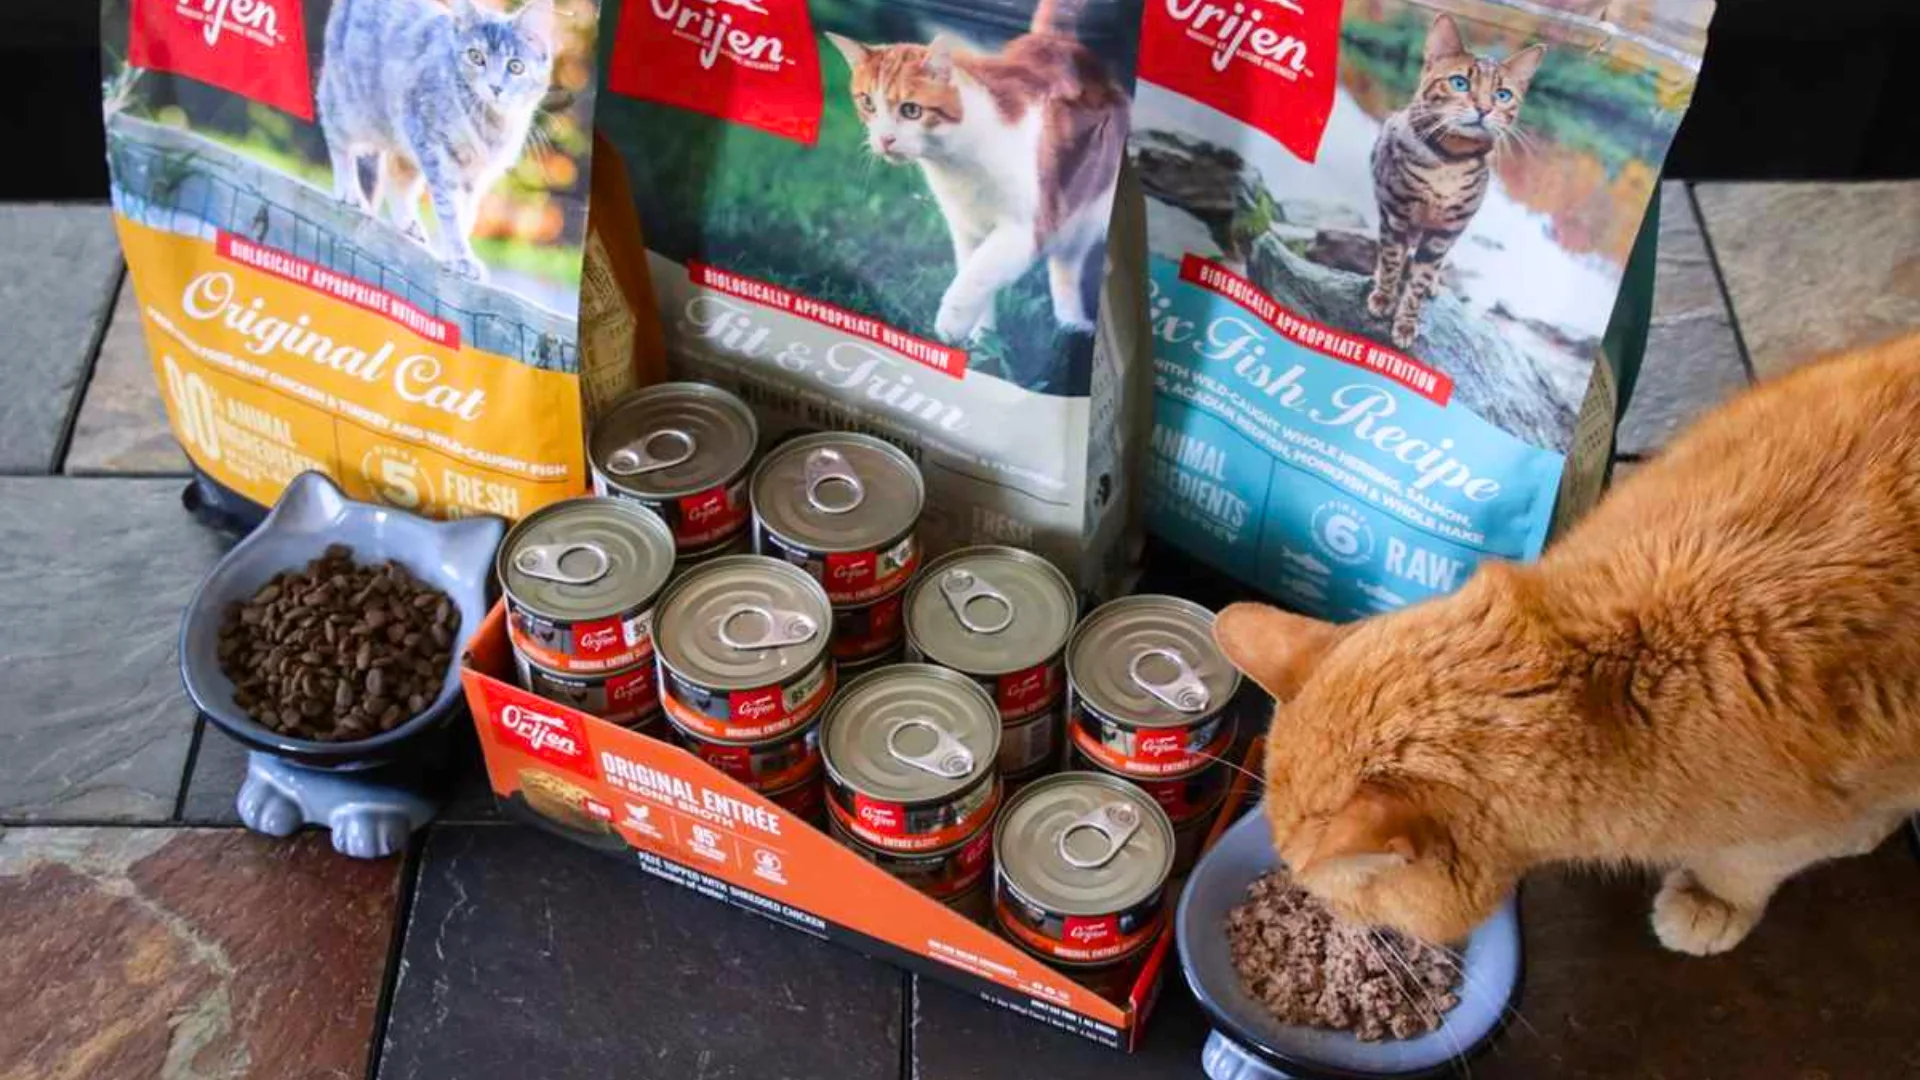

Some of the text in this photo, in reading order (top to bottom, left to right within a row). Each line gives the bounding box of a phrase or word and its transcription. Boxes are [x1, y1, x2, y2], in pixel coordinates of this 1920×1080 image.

[230, 239, 446, 341] BIOLOGICALLY APPROPRIATE NUTRITION
[704, 268, 949, 368] BIOLOGICALLY APPROPRIATE NUTRITION
[182, 270, 395, 381] Original
[394, 354, 486, 421] Cat
[1200, 264, 1437, 393] BIOLOGICALLY APPROPRIATE NUTRITION
[681, 295, 771, 358] Fit
[774, 342, 814, 373] &
[816, 341, 971, 431] Trim
[227, 397, 297, 448] ANIMAL
[1191, 372, 1281, 431] WILD-CAUGHT
[1281, 425, 1341, 456] WHOLE
[1193, 316, 1309, 411] Fish
[1309, 383, 1500, 501] Recipe
[425, 431, 528, 472] WILD-CAUGHT
[1151, 424, 1226, 482] ANIMAL
[382, 457, 419, 508] 5
[444, 467, 519, 518] FRESH
[1325, 513, 1359, 554] 6
[1382, 493, 1437, 530] WHOLE
[1385, 536, 1465, 592] RAW
[502, 705, 575, 754] Orijen
[601, 752, 699, 804] ORIGINAL
[701, 788, 781, 835] ENTRÉE
[628, 781, 675, 806] BONE
[678, 800, 735, 828] BROTH
[701, 875, 728, 892] WITH
[782, 905, 826, 931] CHICKEN
